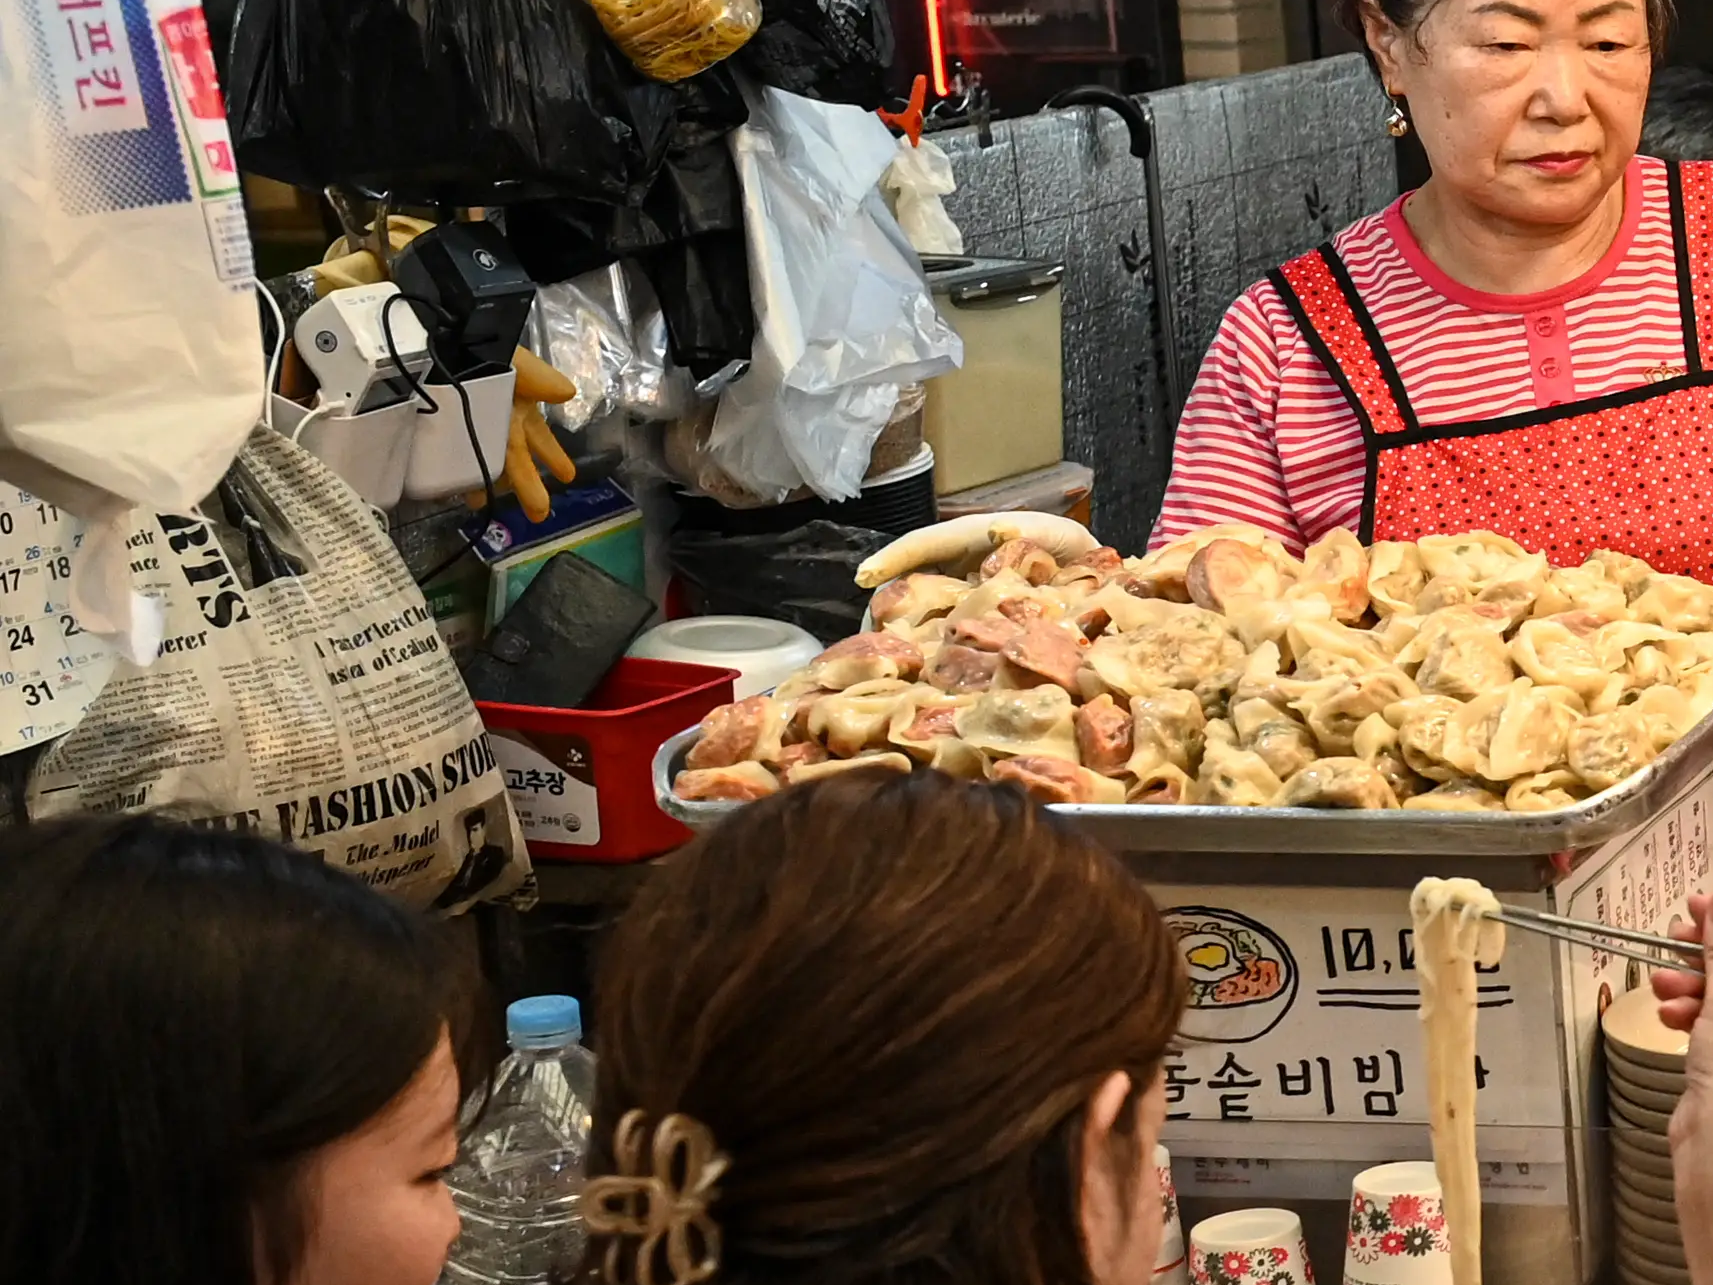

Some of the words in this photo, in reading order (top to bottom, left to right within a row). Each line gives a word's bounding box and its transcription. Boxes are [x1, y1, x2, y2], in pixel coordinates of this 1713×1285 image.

[0, 511, 14, 535] 0
[46, 556, 72, 582] 18
[7, 625, 36, 652] 24
[21, 679, 55, 708] 31
[275, 762, 438, 843] FASHION
[345, 842, 380, 866] The
[1164, 1046, 1490, 1122] 돌솥비빔
